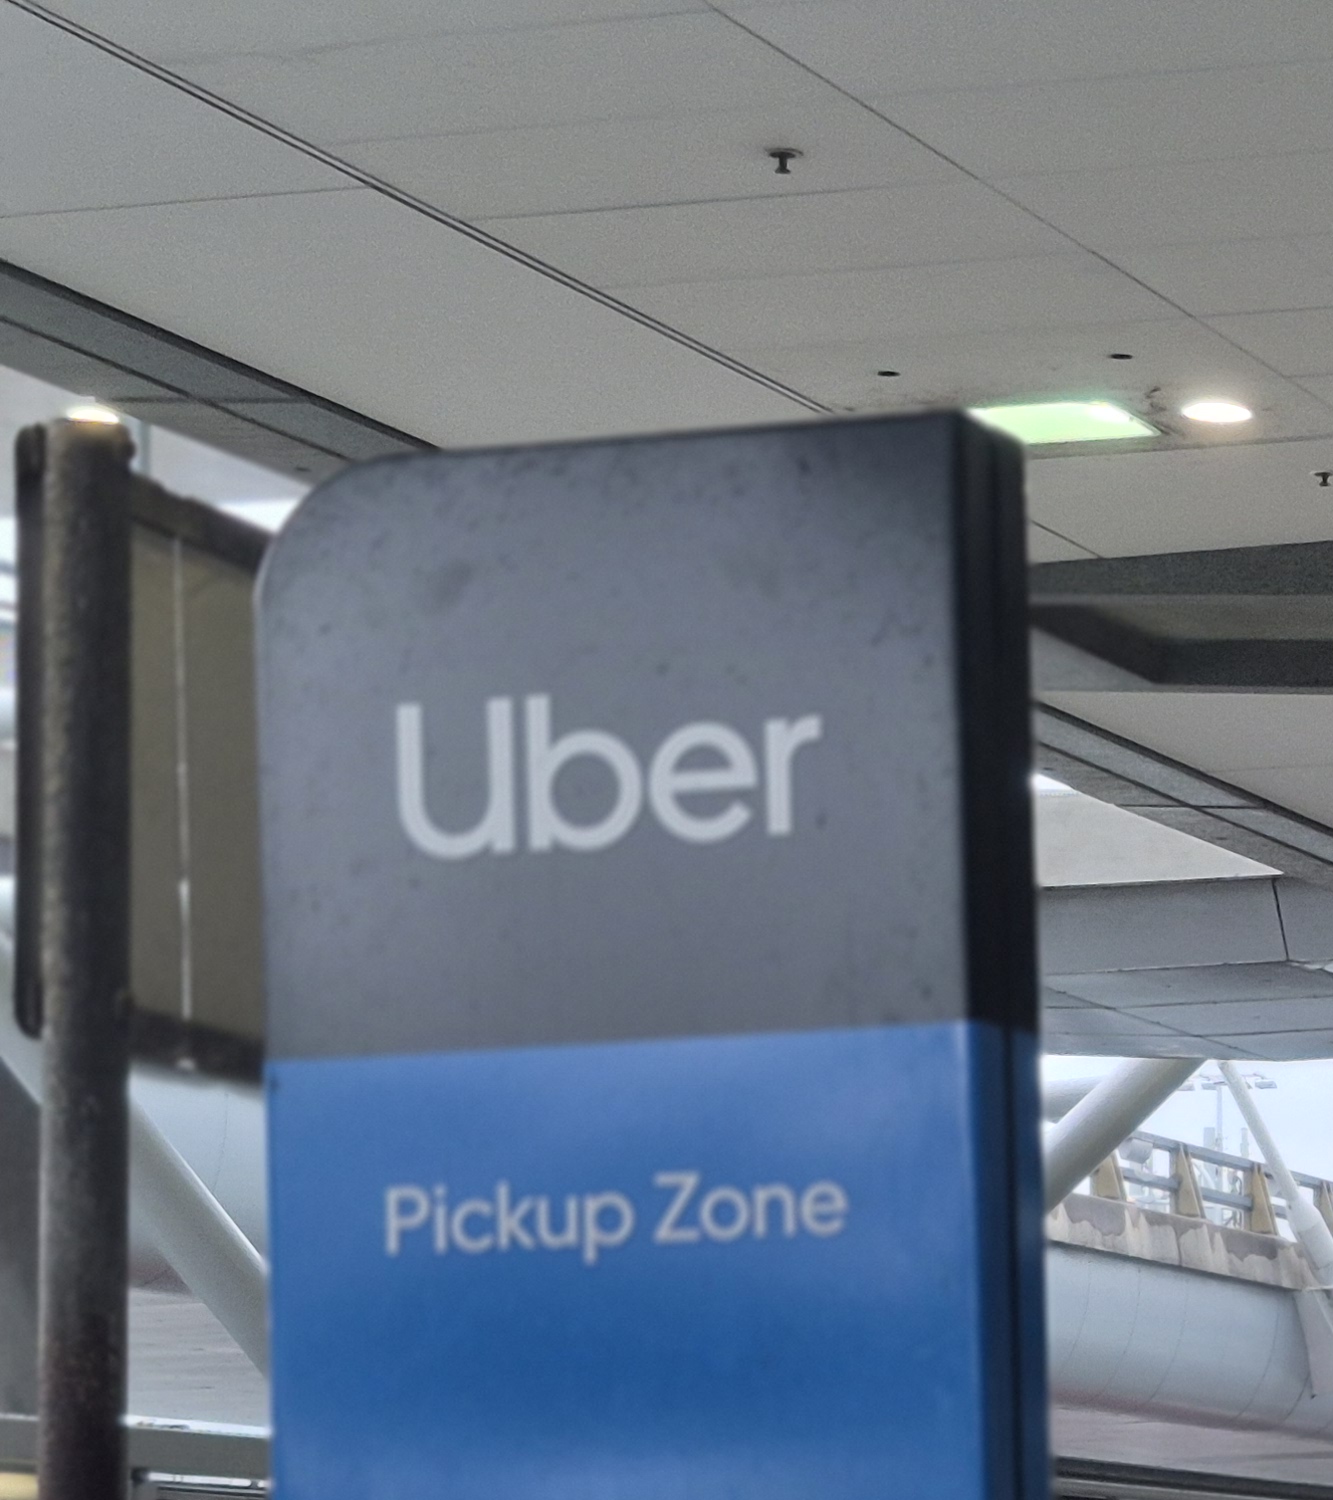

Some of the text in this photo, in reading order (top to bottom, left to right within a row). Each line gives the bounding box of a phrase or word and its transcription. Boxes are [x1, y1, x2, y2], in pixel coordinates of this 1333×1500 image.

[396, 693, 823, 860] Uber
[384, 1171, 849, 1265] Pickup Zone
